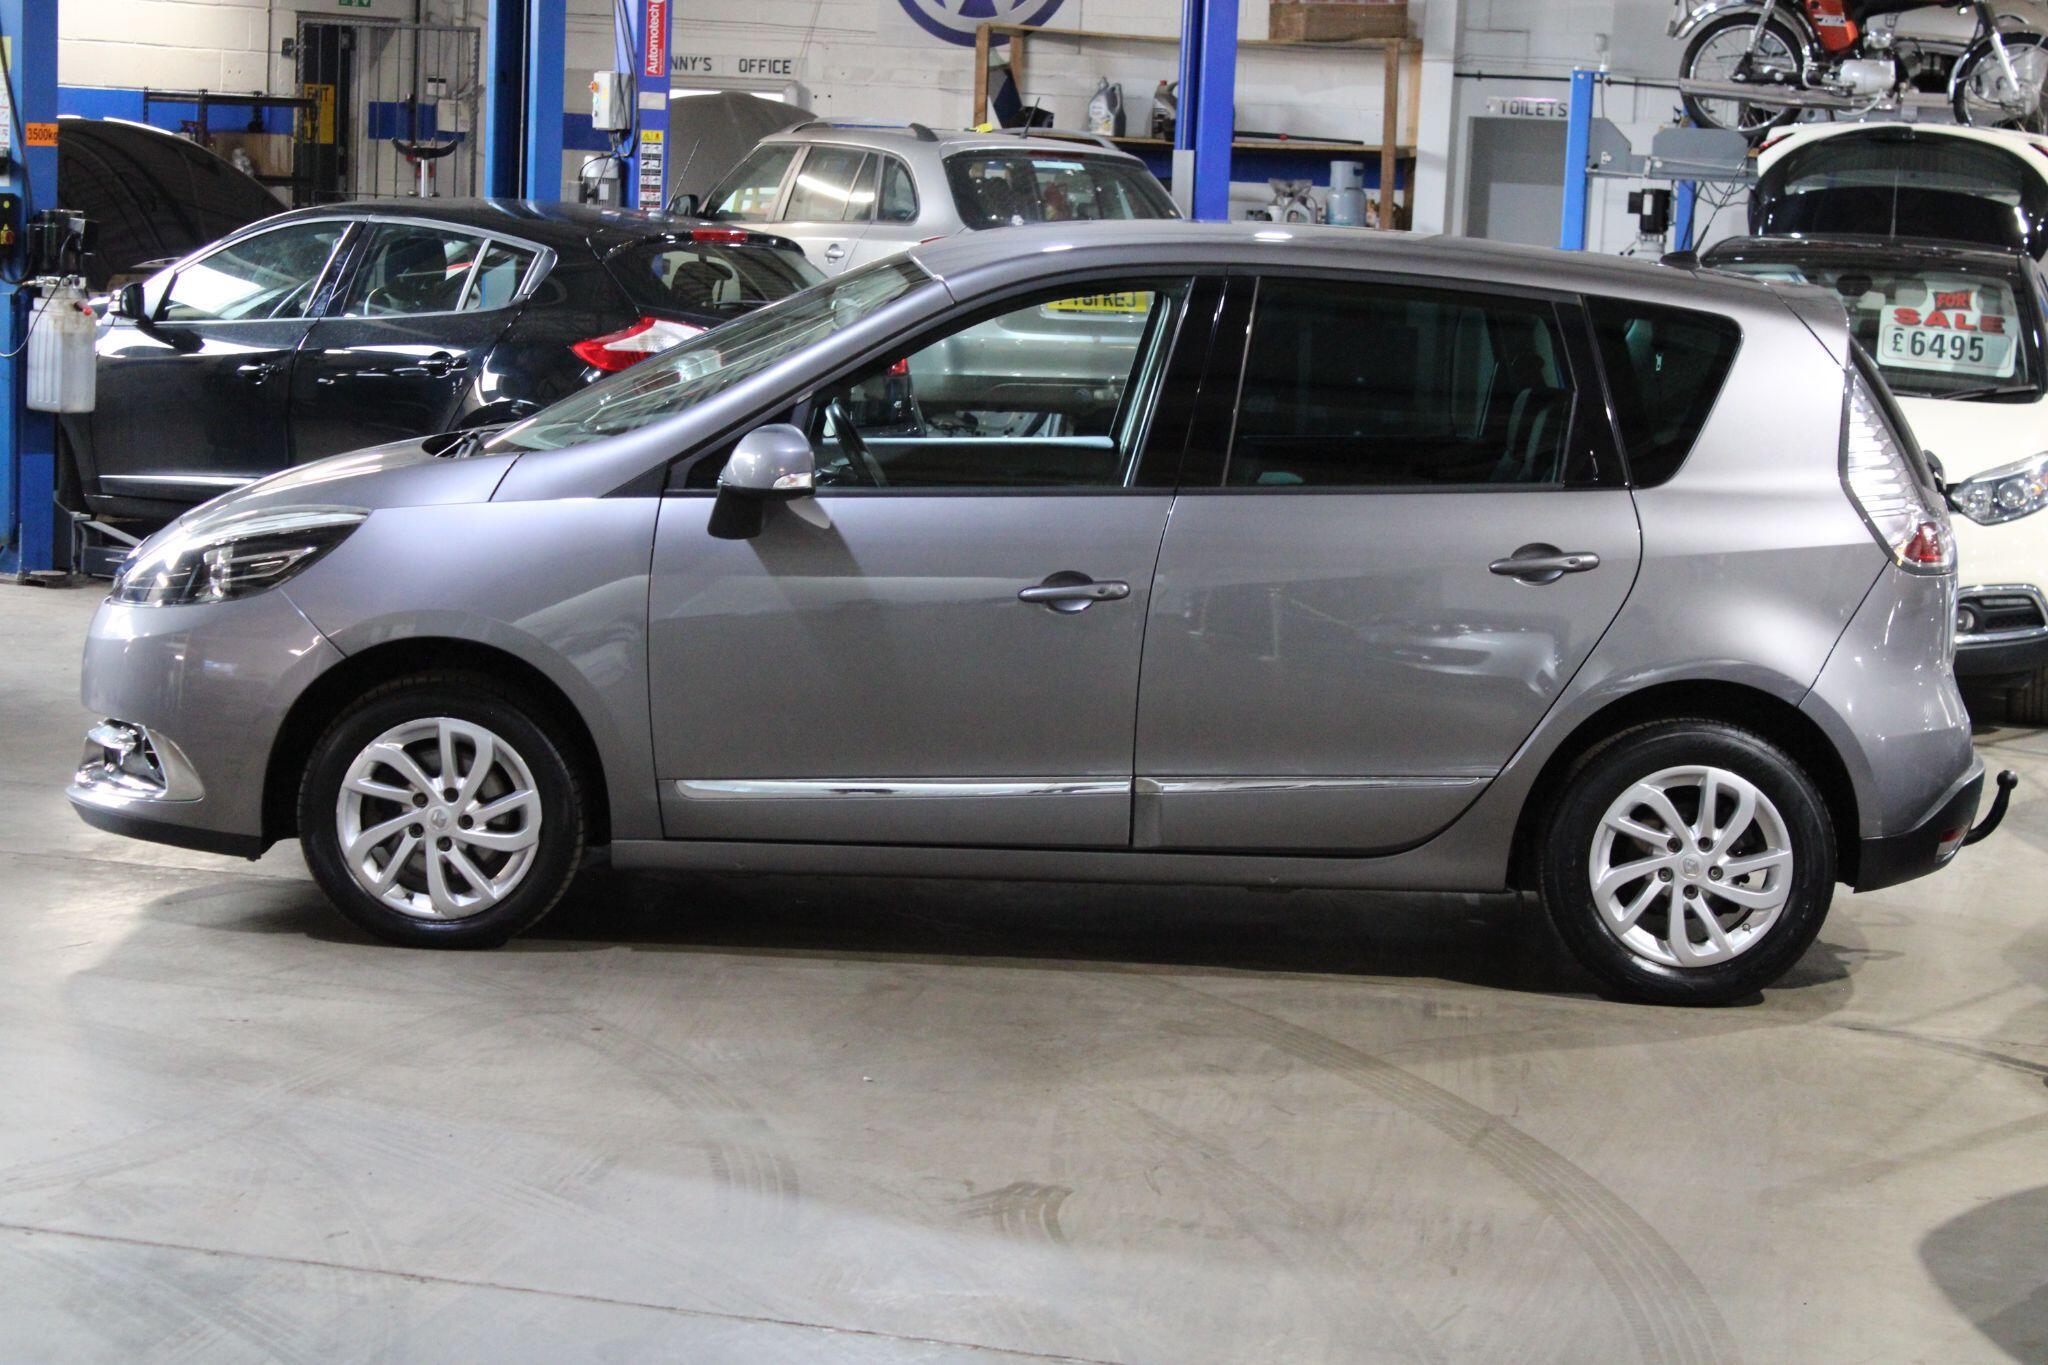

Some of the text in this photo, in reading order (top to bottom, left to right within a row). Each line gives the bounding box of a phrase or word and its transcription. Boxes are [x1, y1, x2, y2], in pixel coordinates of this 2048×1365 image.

[647, 4, 660, 74] Automotech
[739, 58, 791, 74] OFFICE
[1500, 101, 1567, 117] TOILETS
[1936, 291, 1968, 308] FOR
[1893, 308, 2005, 334] SALE
[1892, 330, 1984, 363] £6495
